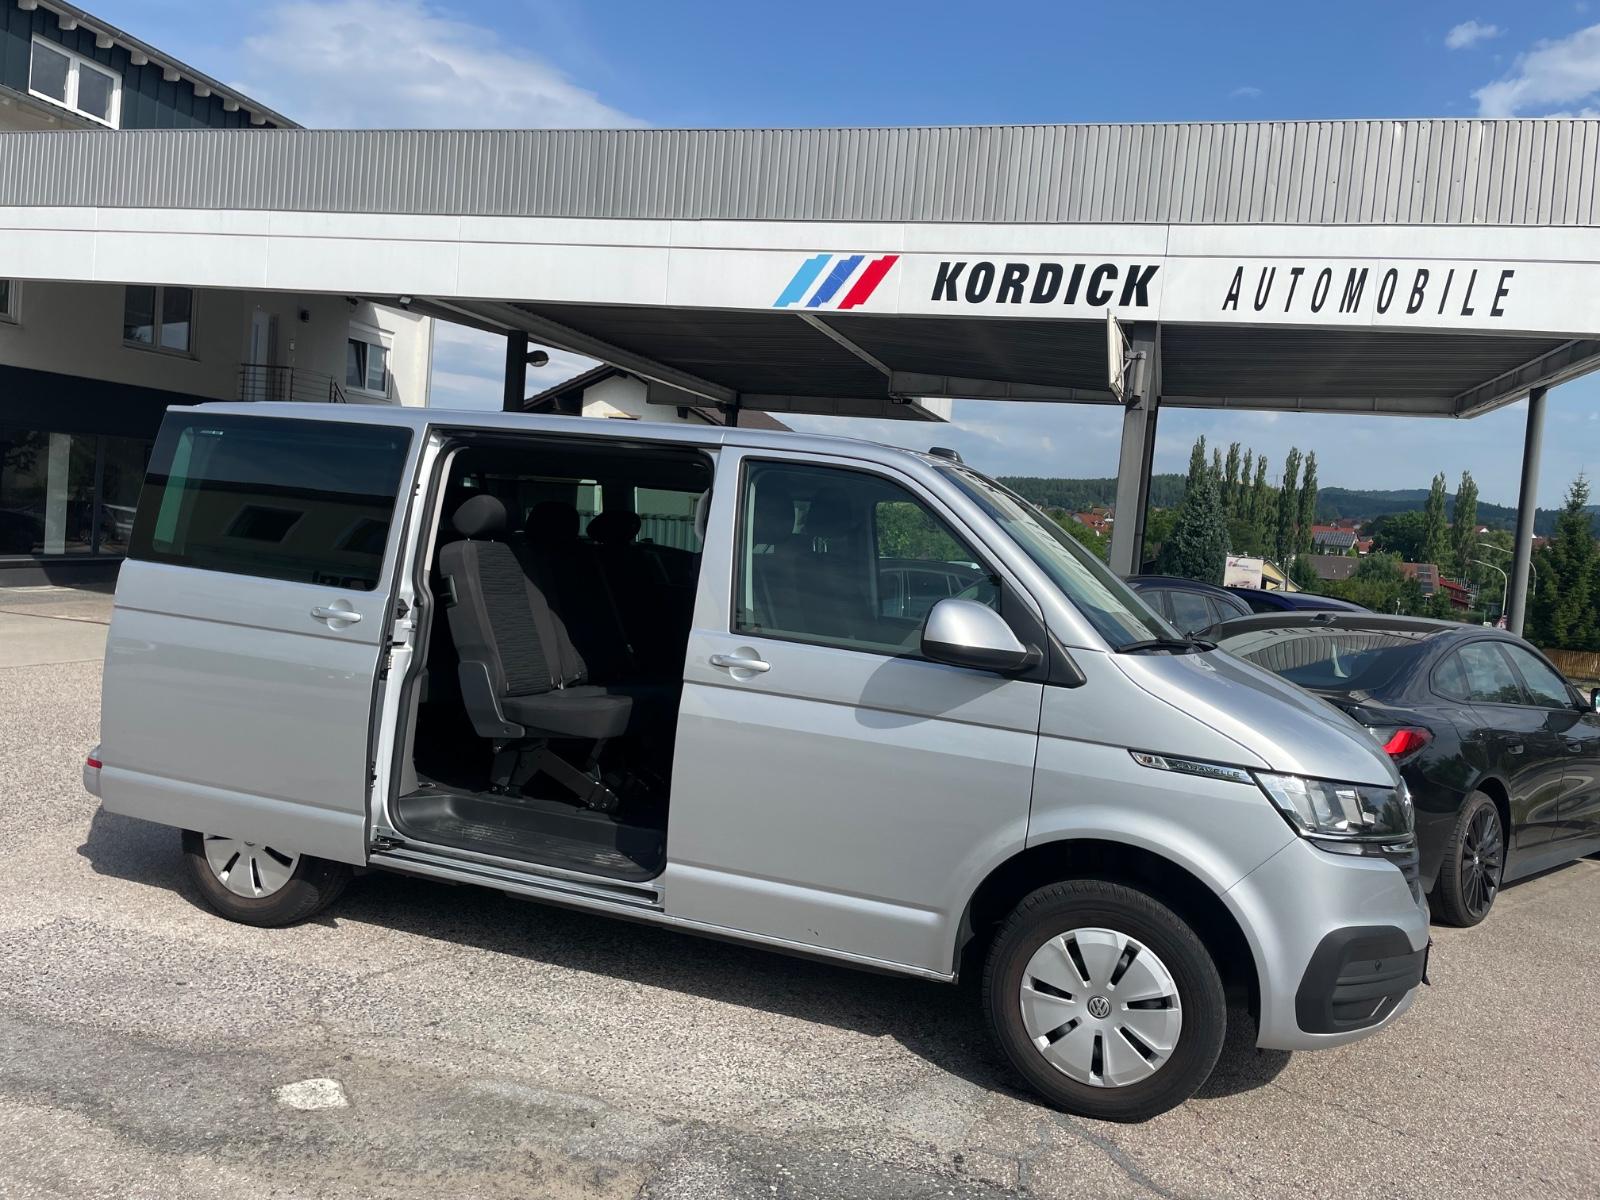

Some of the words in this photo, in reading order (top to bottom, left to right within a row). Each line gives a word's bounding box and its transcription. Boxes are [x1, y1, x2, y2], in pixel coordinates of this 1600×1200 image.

[931, 261, 1160, 307] KORDICK
[1222, 266, 1515, 317] AUTOMOBILE
[1089, 997, 1110, 1018] VW
